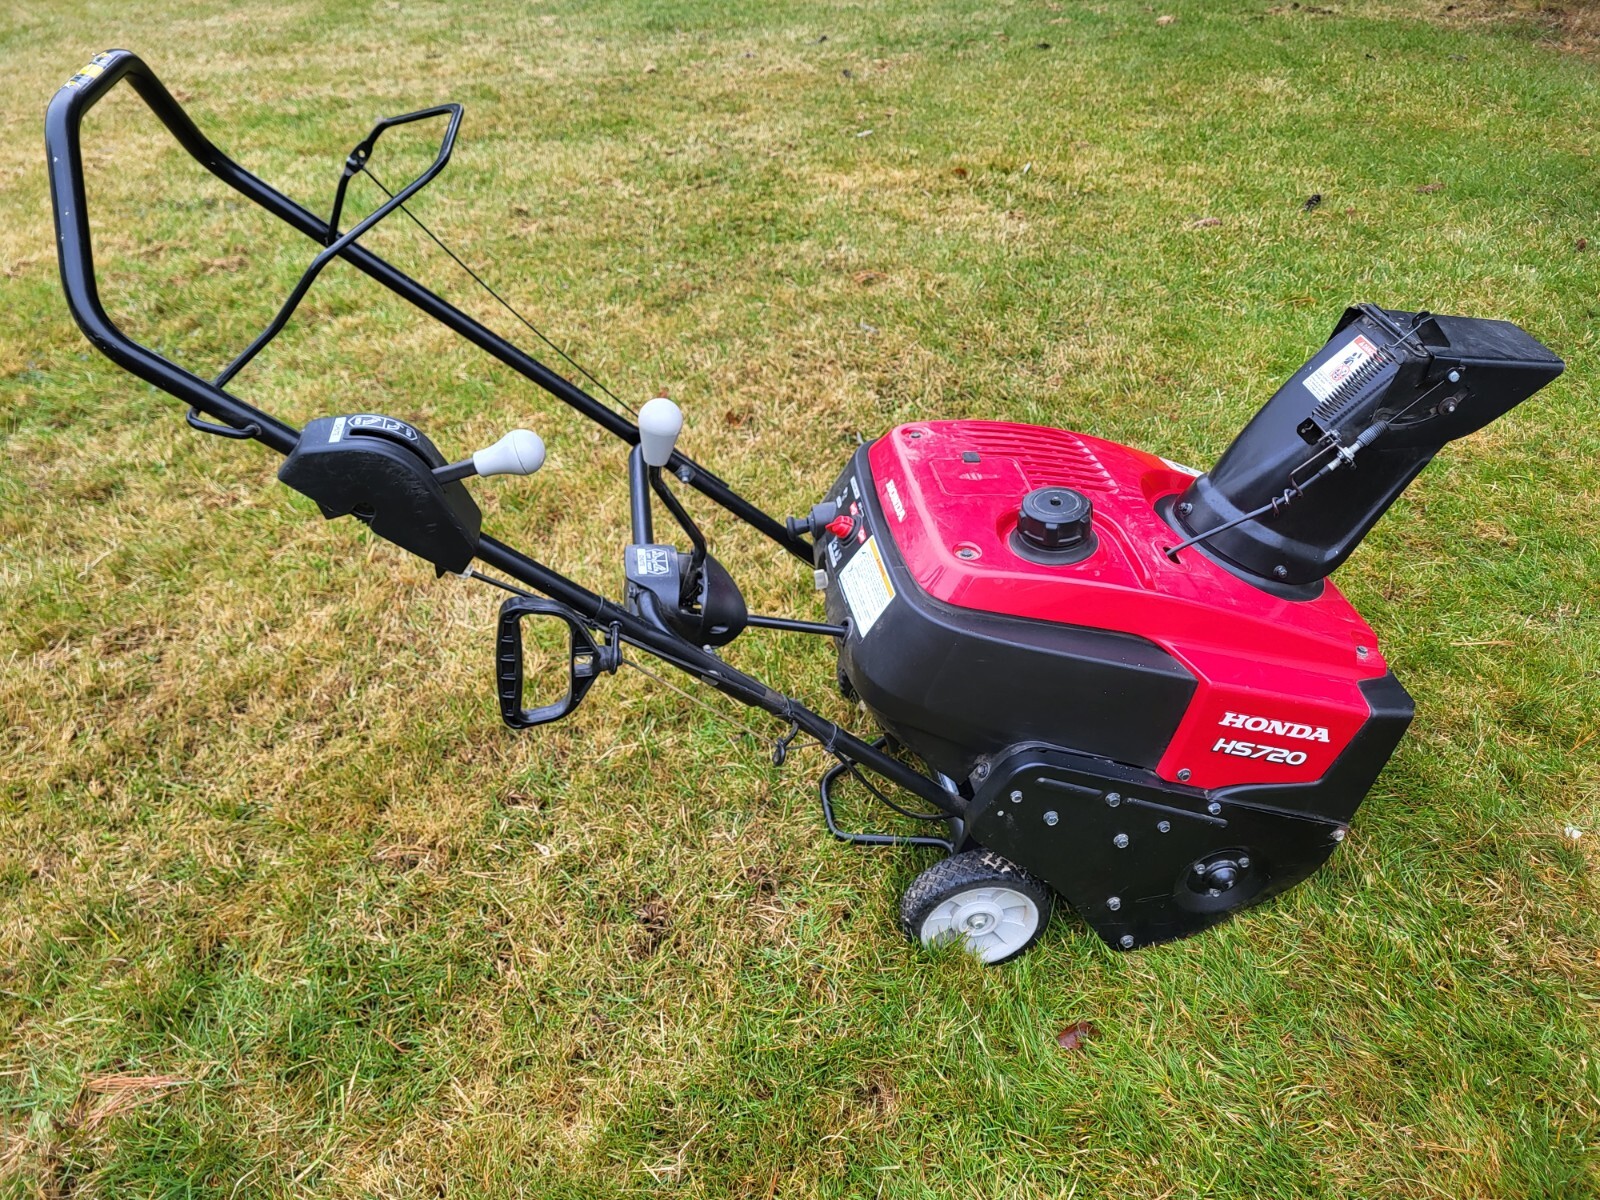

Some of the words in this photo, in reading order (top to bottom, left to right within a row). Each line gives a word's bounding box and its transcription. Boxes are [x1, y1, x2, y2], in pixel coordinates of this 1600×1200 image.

[885, 479, 906, 522] HONDA
[1218, 711, 1330, 743] HONDA
[1211, 738, 1308, 766] HS720
